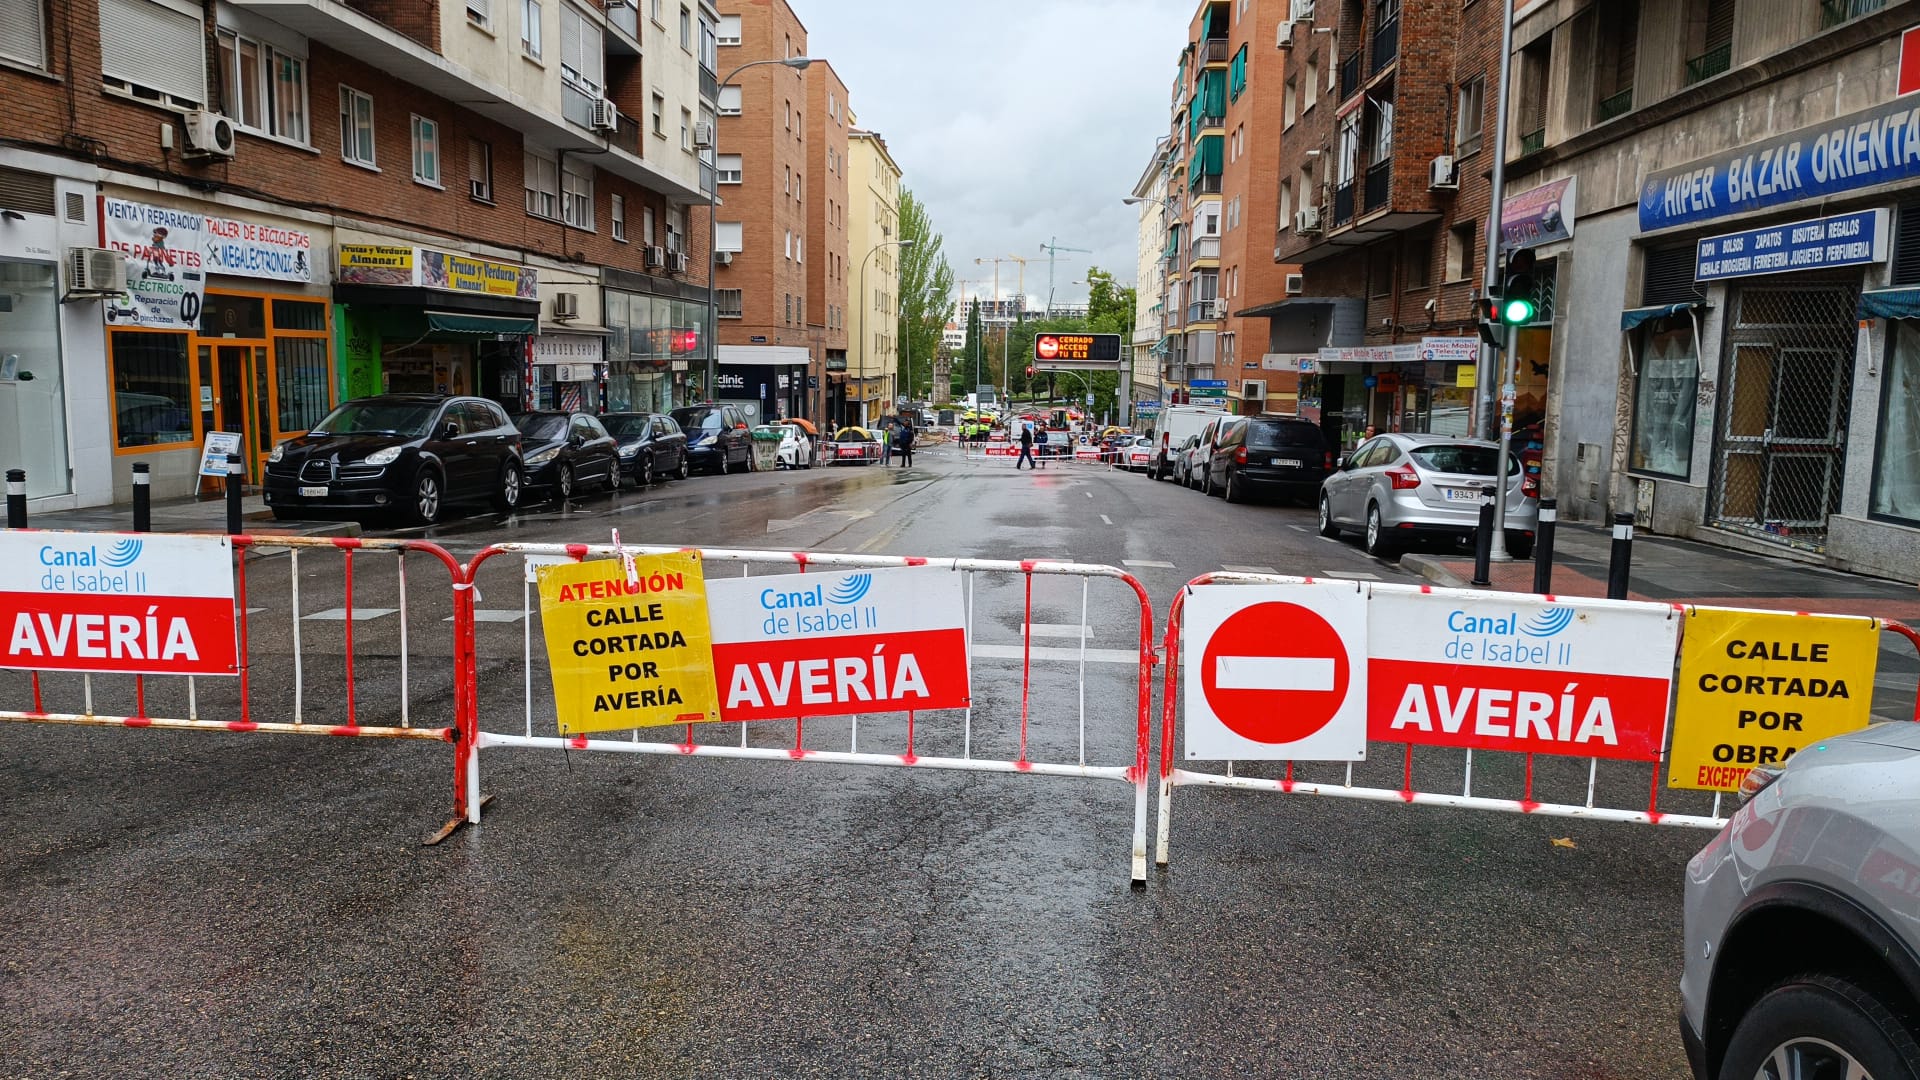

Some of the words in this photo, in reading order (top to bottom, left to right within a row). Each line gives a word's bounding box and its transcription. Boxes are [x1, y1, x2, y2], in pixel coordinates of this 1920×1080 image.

[1664, 166, 1716, 217] HIPER
[1727, 141, 1802, 203] BAZAR
[107, 201, 138, 221] VENTA
[139, 207, 146, 223] Y
[205, 218, 240, 237] TALLER
[243, 225, 256, 241] DE
[259, 228, 310, 249] BICICLETAS
[1701, 243, 1715, 257] ROPA
[1722, 238, 1744, 253] BOLSOS
[1755, 232, 1782, 249] ZAPATOS
[1791, 224, 1825, 244] BISUTERIA
[1827, 219, 1860, 238] REGALOS
[221, 245, 293, 273] MEGALECTRONIC
[341, 245, 367, 254] Frutas
[376, 246, 412, 255] Verduras
[350, 255, 397, 265] Almanar
[1699, 261, 1720, 276] MENAJE
[1721, 257, 1751, 273] DROGUERIA
[1753, 251, 1789, 269] FERRETERIA
[1790, 247, 1824, 265] JUGUETES
[1826, 241, 1870, 262] PERFUMERIA
[450, 257, 475, 275] Frutas
[478, 264, 483, 279] y
[484, 262, 516, 282] Verduras
[455, 277, 482, 292] Almanar
[134, 294, 178, 306] Reparación
[140, 314, 174, 323] pinchazos
[540, 343, 574, 356] BARBER
[577, 344, 596, 356] SHOP
[1059, 336, 1094, 344] CERRADO
[1454, 491, 1474, 499] 9343
[39, 545, 97, 567] Canal
[41, 568, 65, 590] de
[72, 570, 129, 593] Isabel
[136, 572, 146, 593] II
[558, 572, 684, 603] ATENCIÓN
[760, 584, 823, 610] Canal
[586, 604, 664, 628] CALLE
[762, 613, 790, 635] de
[796, 607, 859, 632] Isabel
[865, 606, 876, 628] II
[1448, 609, 1517, 636] Canal
[8, 605, 200, 661] AVERÍA
[573, 630, 687, 657] CORTADA
[1444, 635, 1473, 661] de
[1482, 638, 1551, 664] Isabel
[1558, 644, 1571, 666] II
[1726, 640, 1829, 664] CALLE
[608, 661, 659, 682] POR
[726, 644, 930, 709] AVERÍA
[593, 684, 683, 713] AVERÍA
[1698, 673, 1850, 700] CORTADA
[1390, 682, 1619, 746] AVERÍA
[1738, 710, 1804, 732] POR
